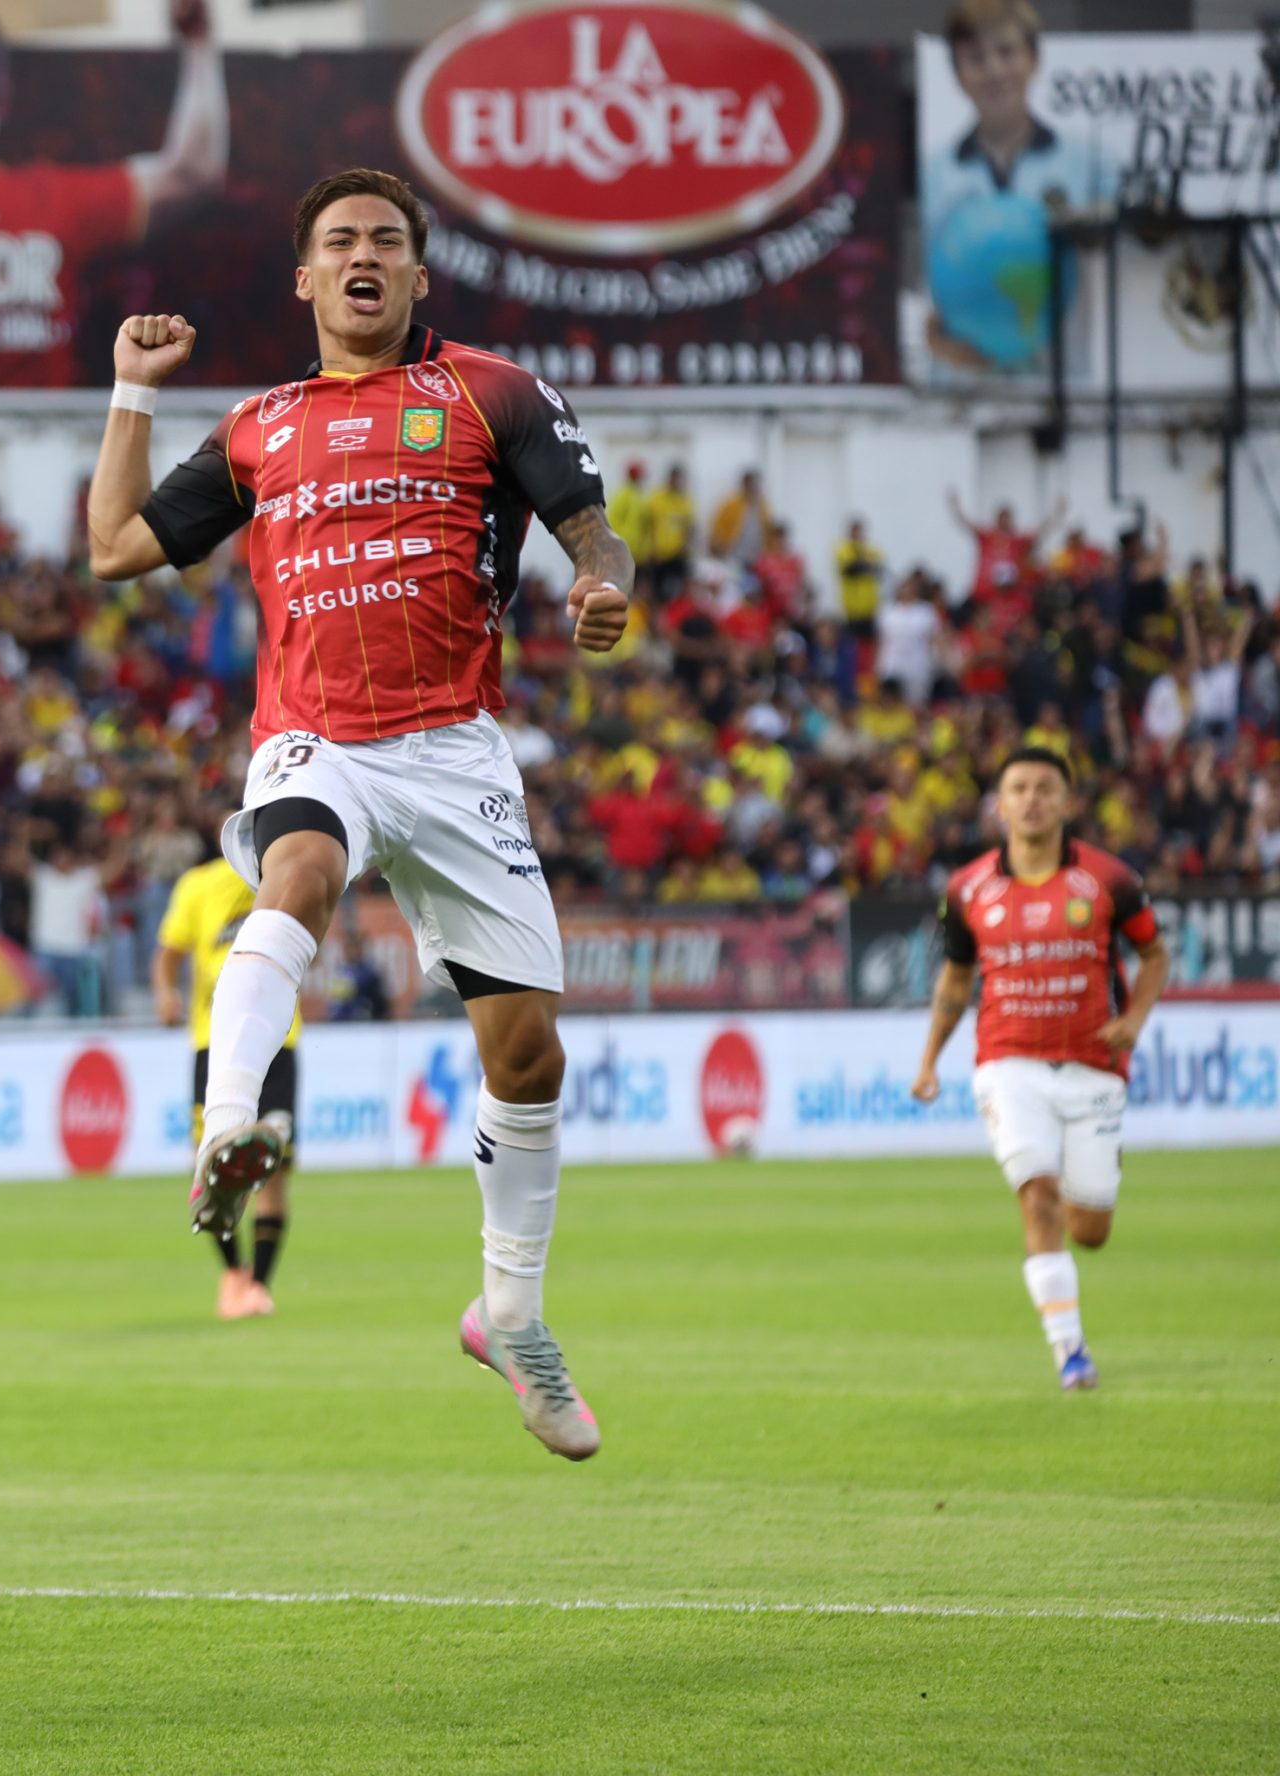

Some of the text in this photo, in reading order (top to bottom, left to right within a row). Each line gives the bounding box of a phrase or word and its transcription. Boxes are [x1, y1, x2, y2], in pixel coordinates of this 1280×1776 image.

[570, 15, 670, 86] LA
[450, 85, 792, 182] EUROPEA
[254, 474, 457, 518] banco austro
[272, 506, 291, 523] del
[276, 537, 434, 584] CHUBB
[288, 577, 420, 619] SEGUROS
[1126, 1024, 1278, 1108] aludsa
